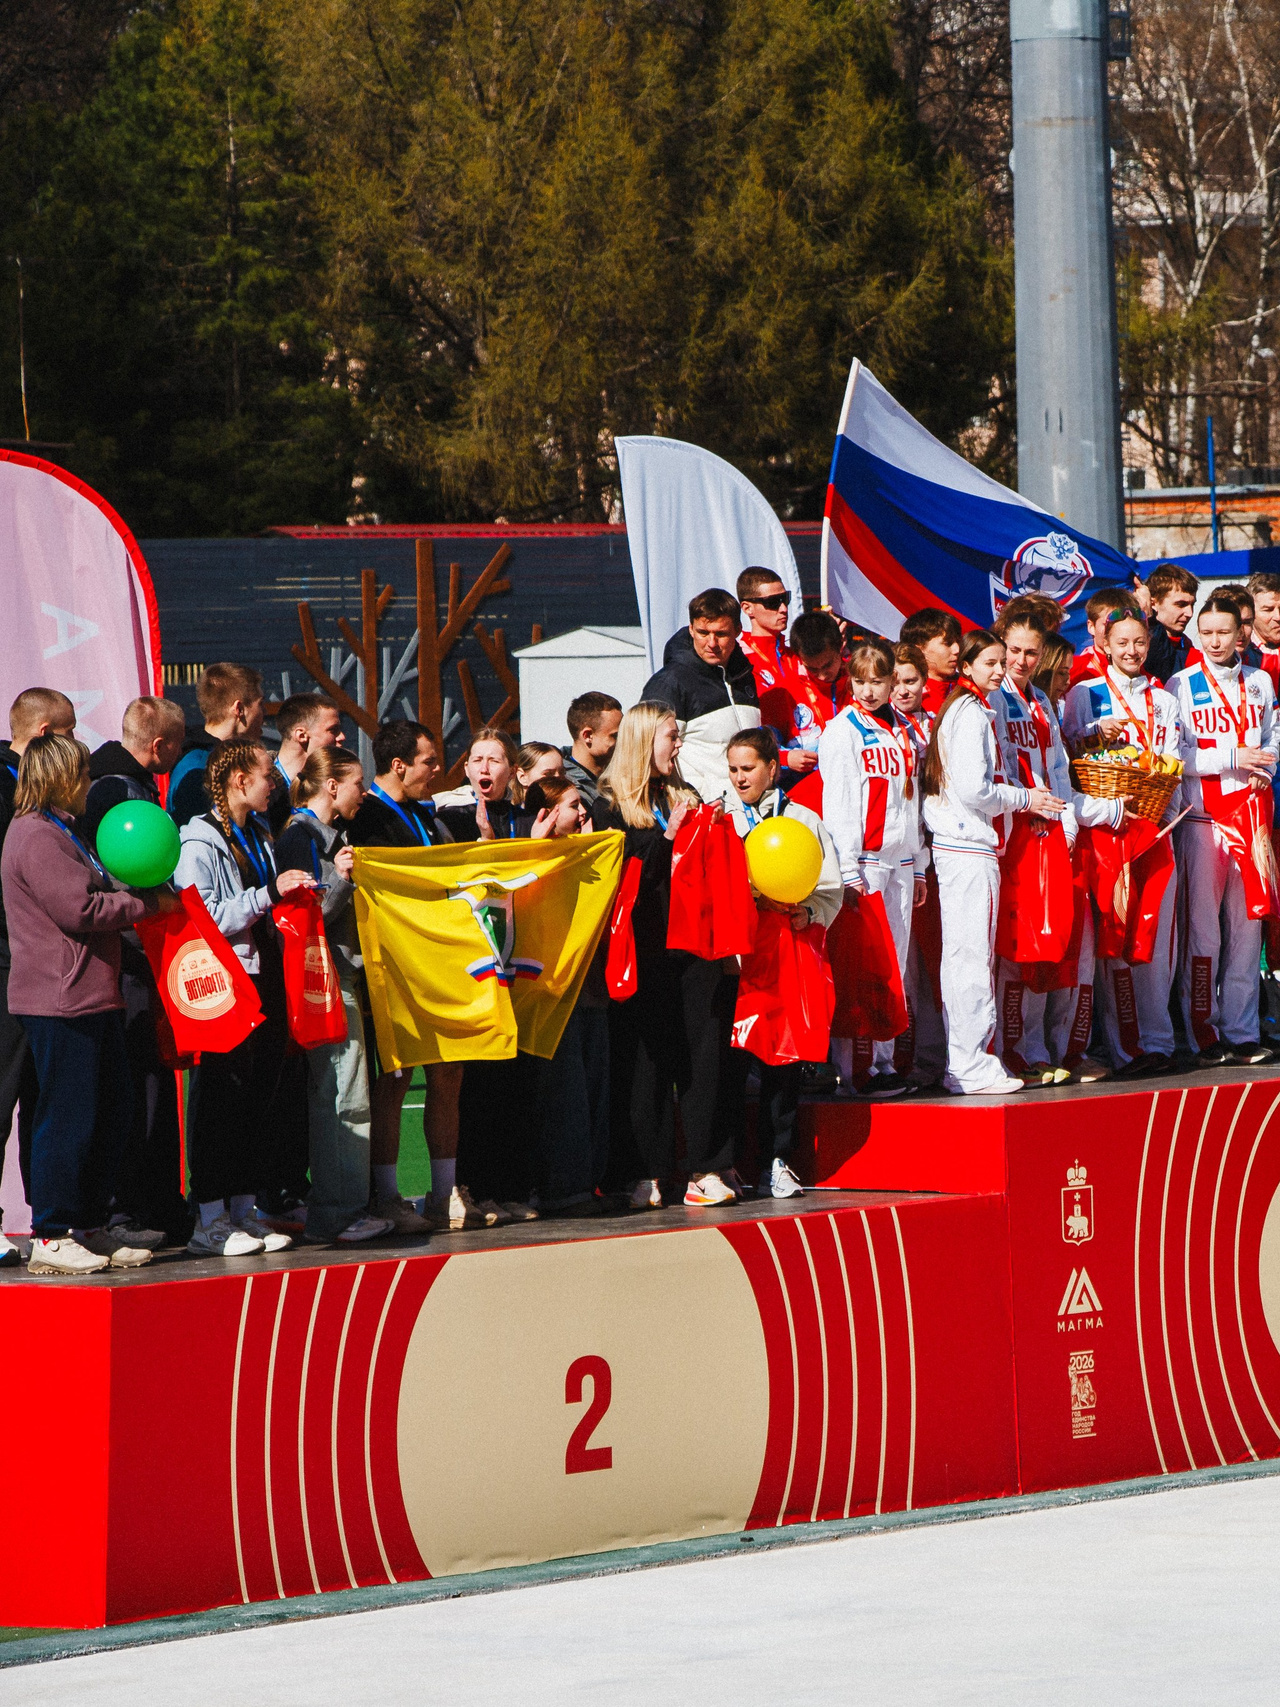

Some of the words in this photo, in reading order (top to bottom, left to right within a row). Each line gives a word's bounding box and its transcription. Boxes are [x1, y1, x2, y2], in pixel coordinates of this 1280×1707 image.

[184, 971, 227, 1002] ЭСТАФЕТА
[1118, 976, 1134, 1024] RUSSIA
[1195, 964, 1208, 1012] RUSSIA
[1007, 989, 1021, 1039] RUSSIA
[1073, 993, 1091, 1043] RUSSIA
[1057, 1316, 1104, 1333] МАГМА
[1069, 1354, 1095, 1370] 2026
[565, 1354, 613, 1475] 2
[1072, 1414, 1096, 1424] ЕДИНСТВА
[1072, 1421, 1094, 1429] НАРОДОВ
[1072, 1427, 1092, 1435] РОССИИ
